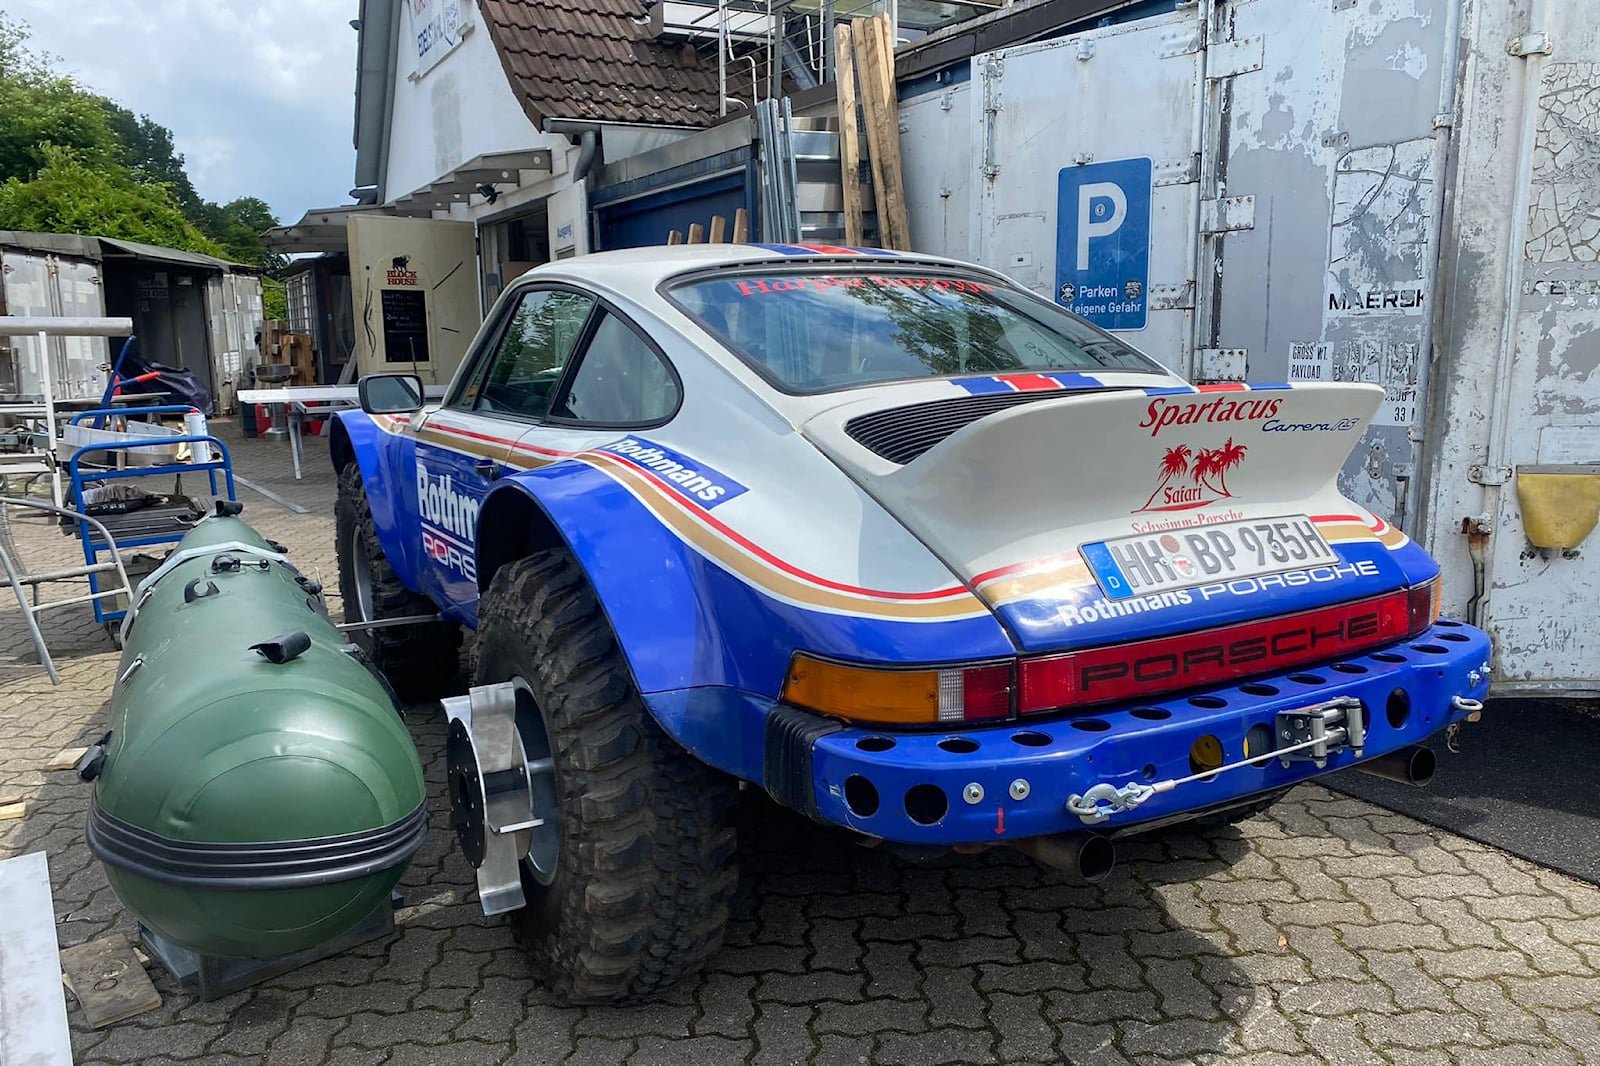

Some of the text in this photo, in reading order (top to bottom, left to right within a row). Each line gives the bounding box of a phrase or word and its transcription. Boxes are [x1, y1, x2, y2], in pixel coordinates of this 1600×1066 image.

[1077, 182, 1127, 270] P
[387, 270, 417, 279] BLOCK
[388, 278, 417, 286] HOUSE
[1079, 285, 1118, 298] Parken
[1075, 303, 1106, 316] eigene
[1108, 301, 1142, 313] Gefahr
[1292, 346, 1328, 360] GROSS WT.
[1291, 365, 1321, 379] PAYLOAD
[1139, 396, 1284, 437] Spartacus
[1262, 419, 1331, 432] Carrera
[603, 438, 726, 501] Rothmans
[1111, 520, 1331, 589] HH BP 935H
[1108, 575, 1122, 590] D
[1056, 560, 1380, 627] Rothmans PORSCHE
[1080, 612, 1380, 691] PORSCHE
